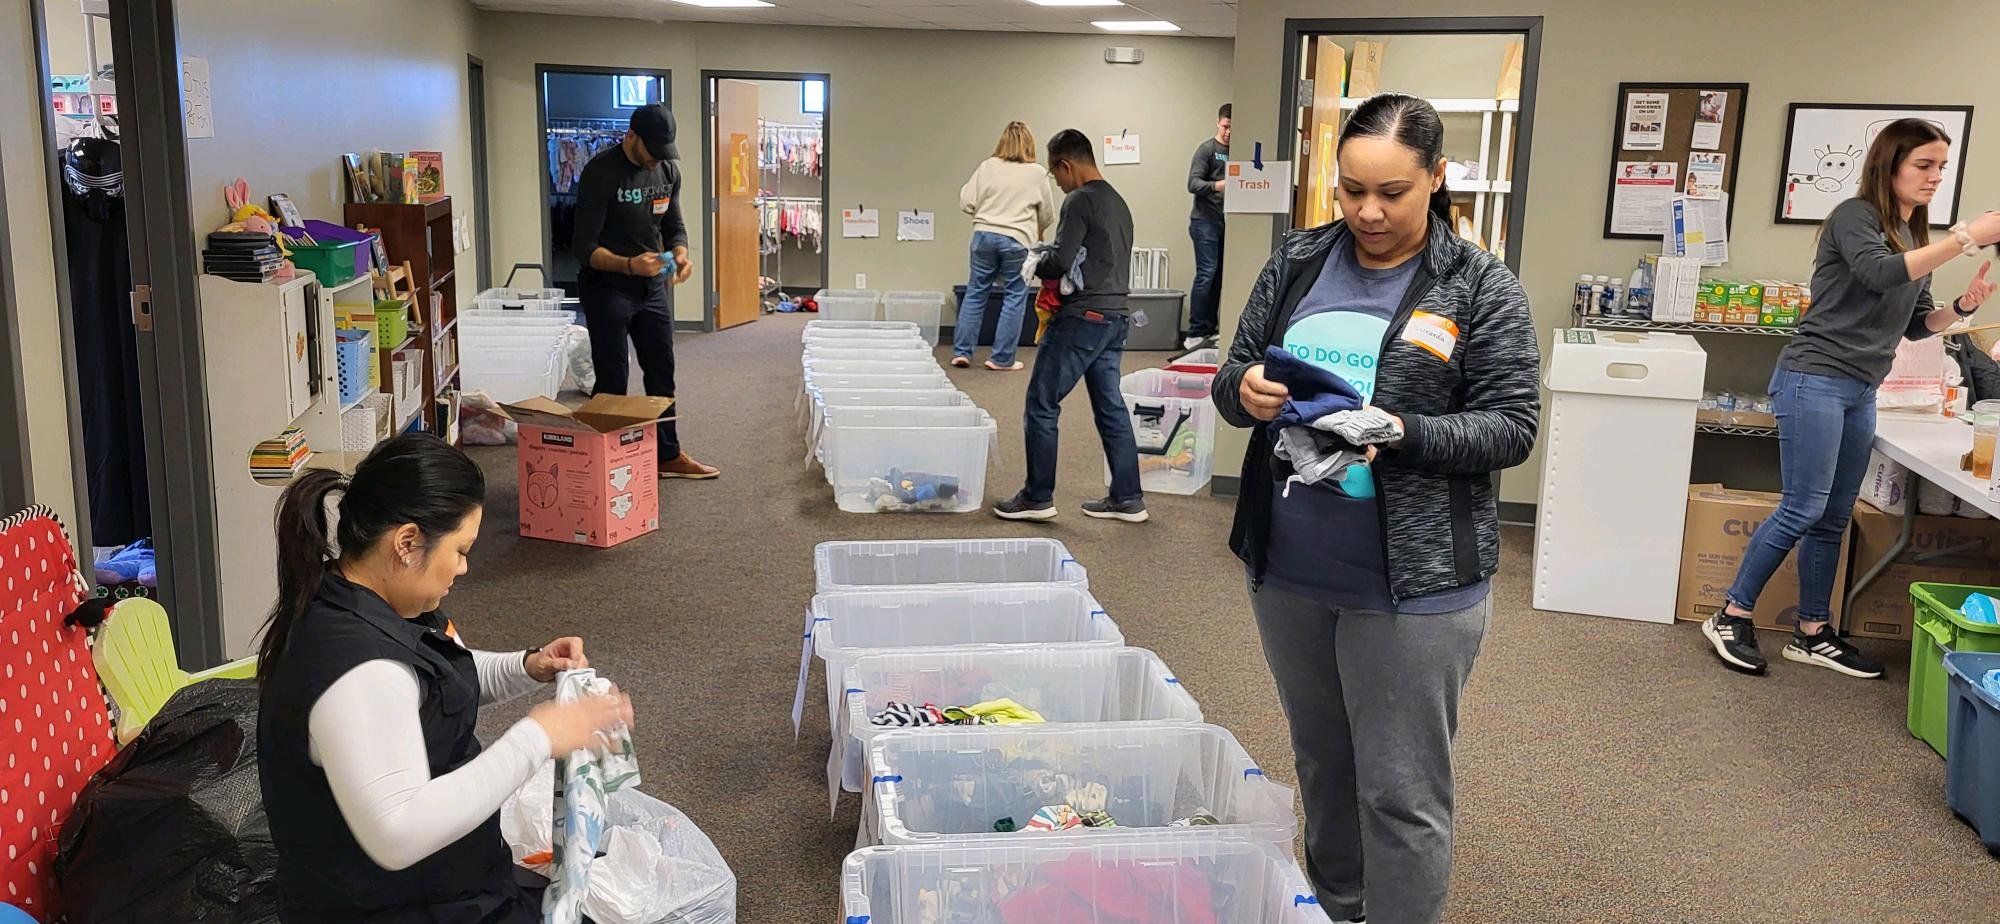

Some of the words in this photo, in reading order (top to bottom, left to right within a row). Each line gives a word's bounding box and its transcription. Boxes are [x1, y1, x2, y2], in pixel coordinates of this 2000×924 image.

[1238, 179, 1271, 190] Trash
[903, 216, 930, 225] Shoes
[1287, 343, 1311, 360] TO
[1315, 347, 1342, 364] DO
[1346, 354, 1378, 369] GO
[589, 530, 597, 540] 4
